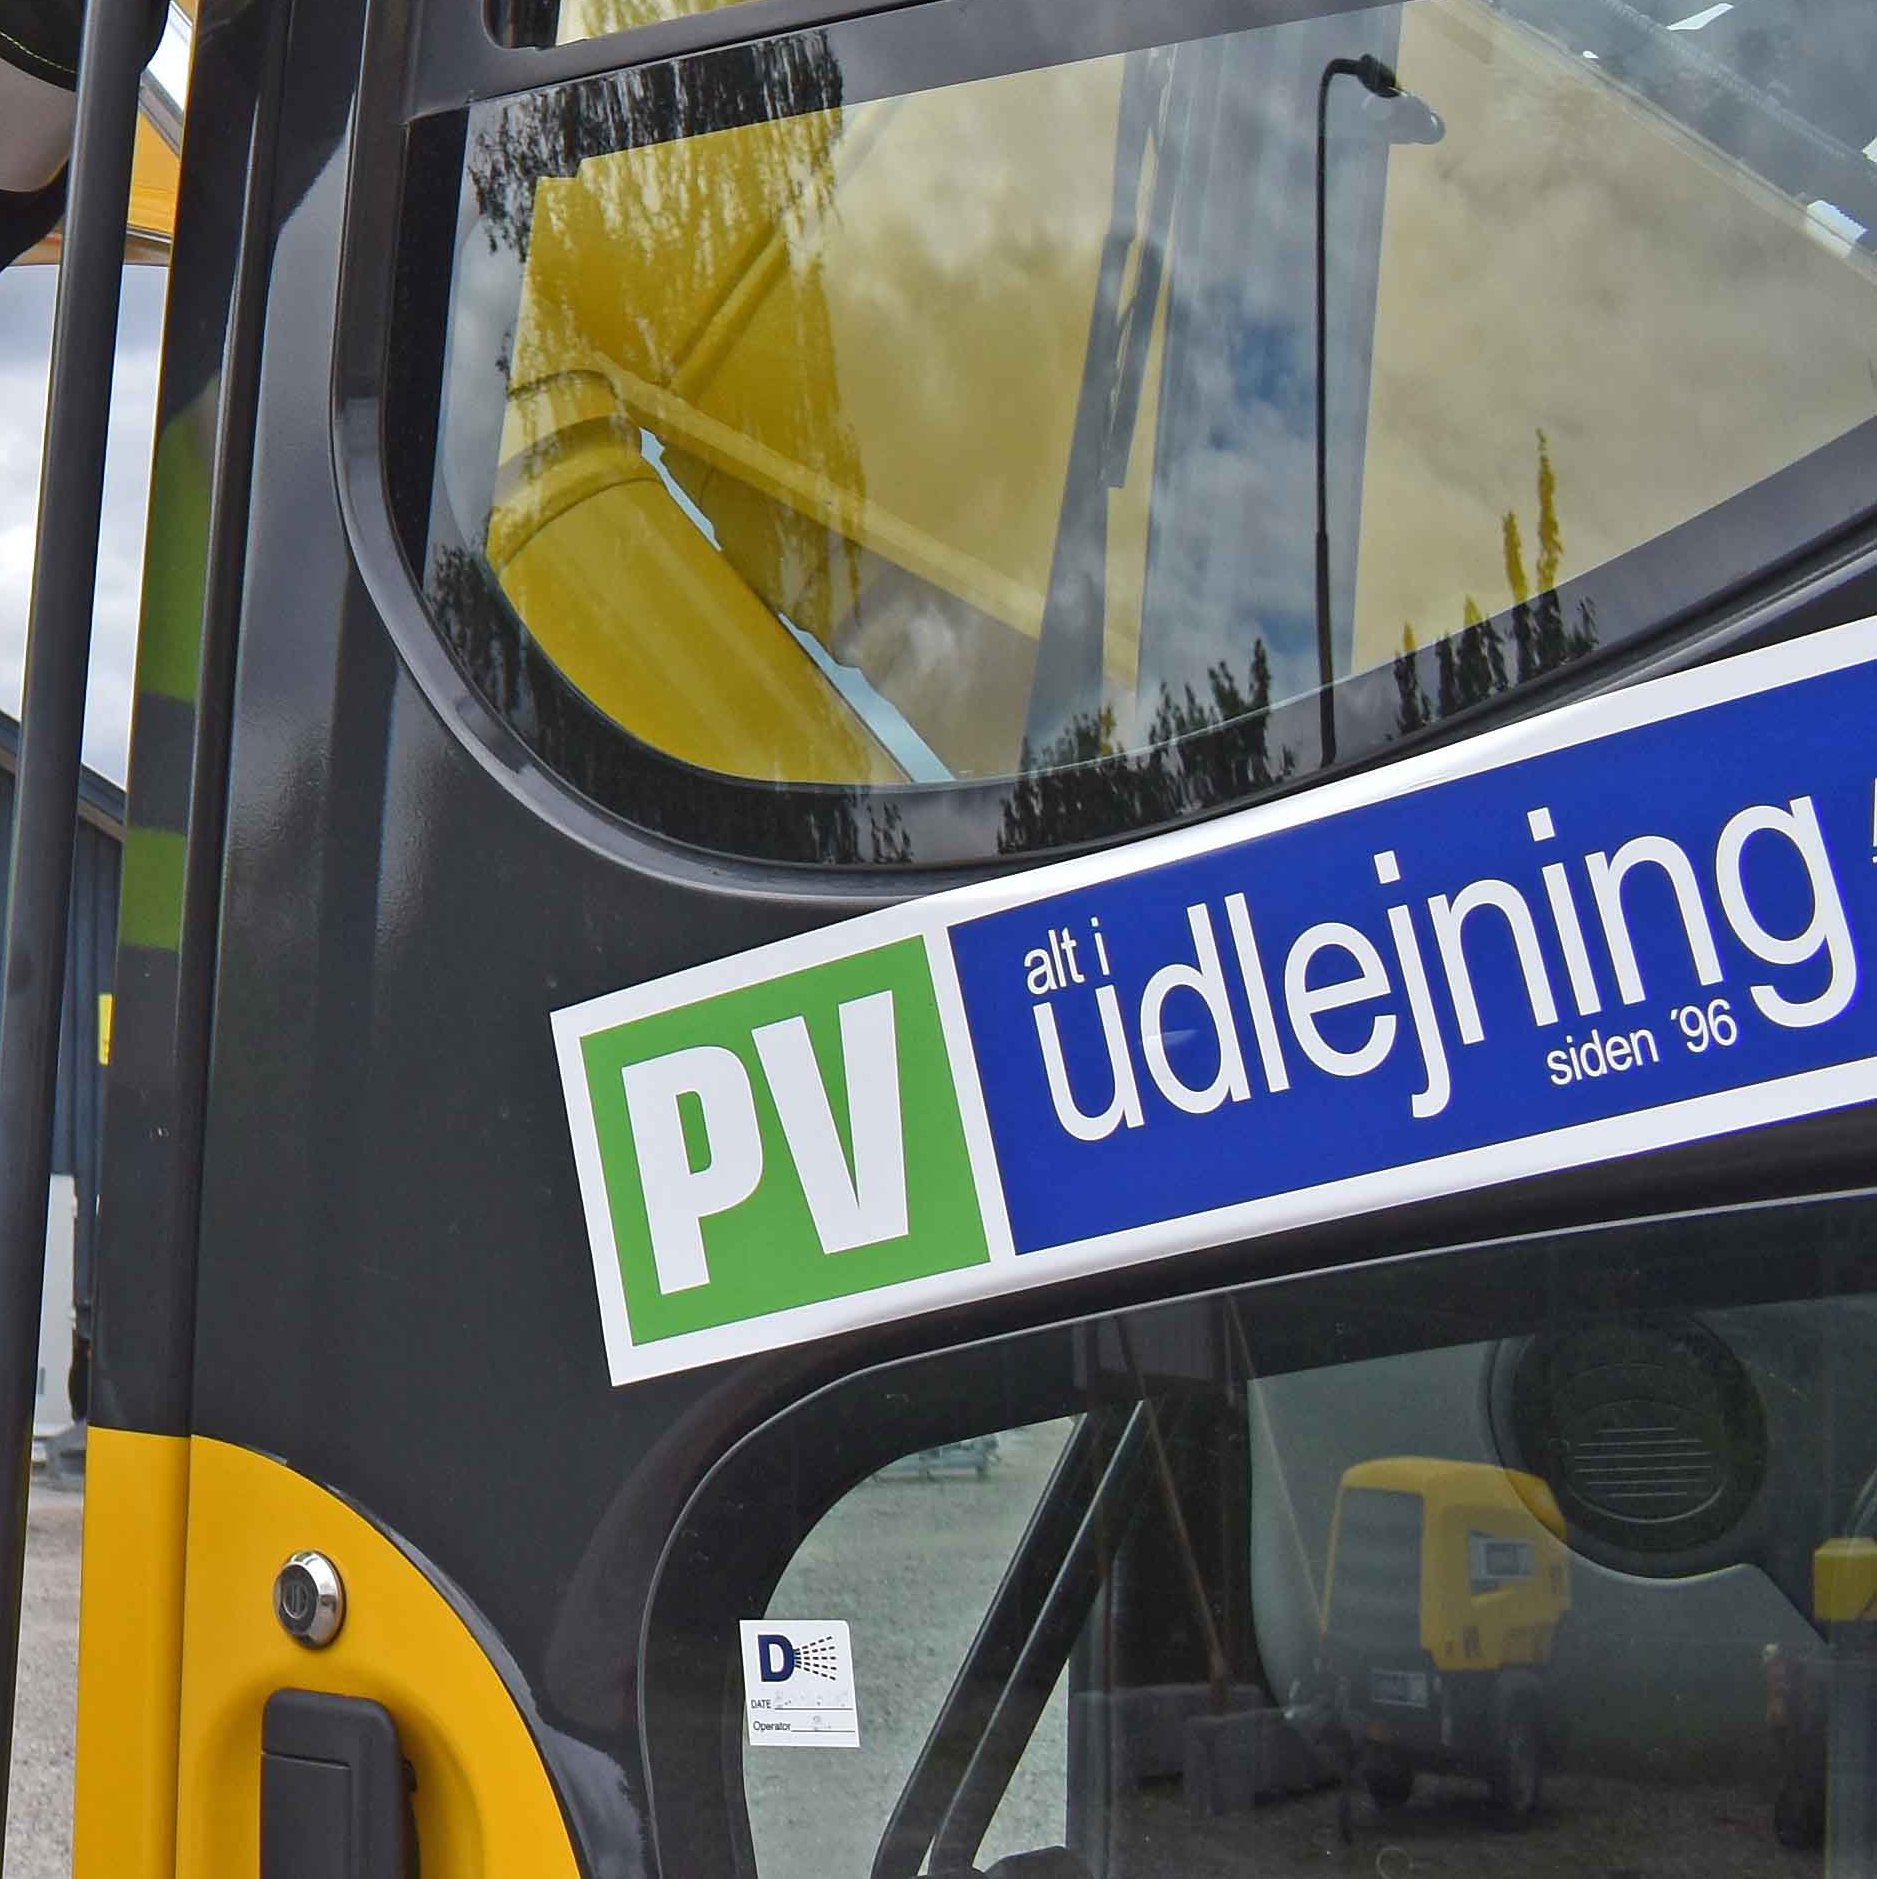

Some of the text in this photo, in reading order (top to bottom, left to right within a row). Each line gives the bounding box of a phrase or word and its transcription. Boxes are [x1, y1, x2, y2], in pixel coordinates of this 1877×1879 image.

[1025, 917, 1109, 995] alt i
[1033, 796, 1857, 1141] udlejning
[1546, 1024, 1660, 1086] siden
[622, 990, 910, 1296] PV
[750, 1699, 773, 1710] DATE
[752, 1720, 792, 1733] Operator
